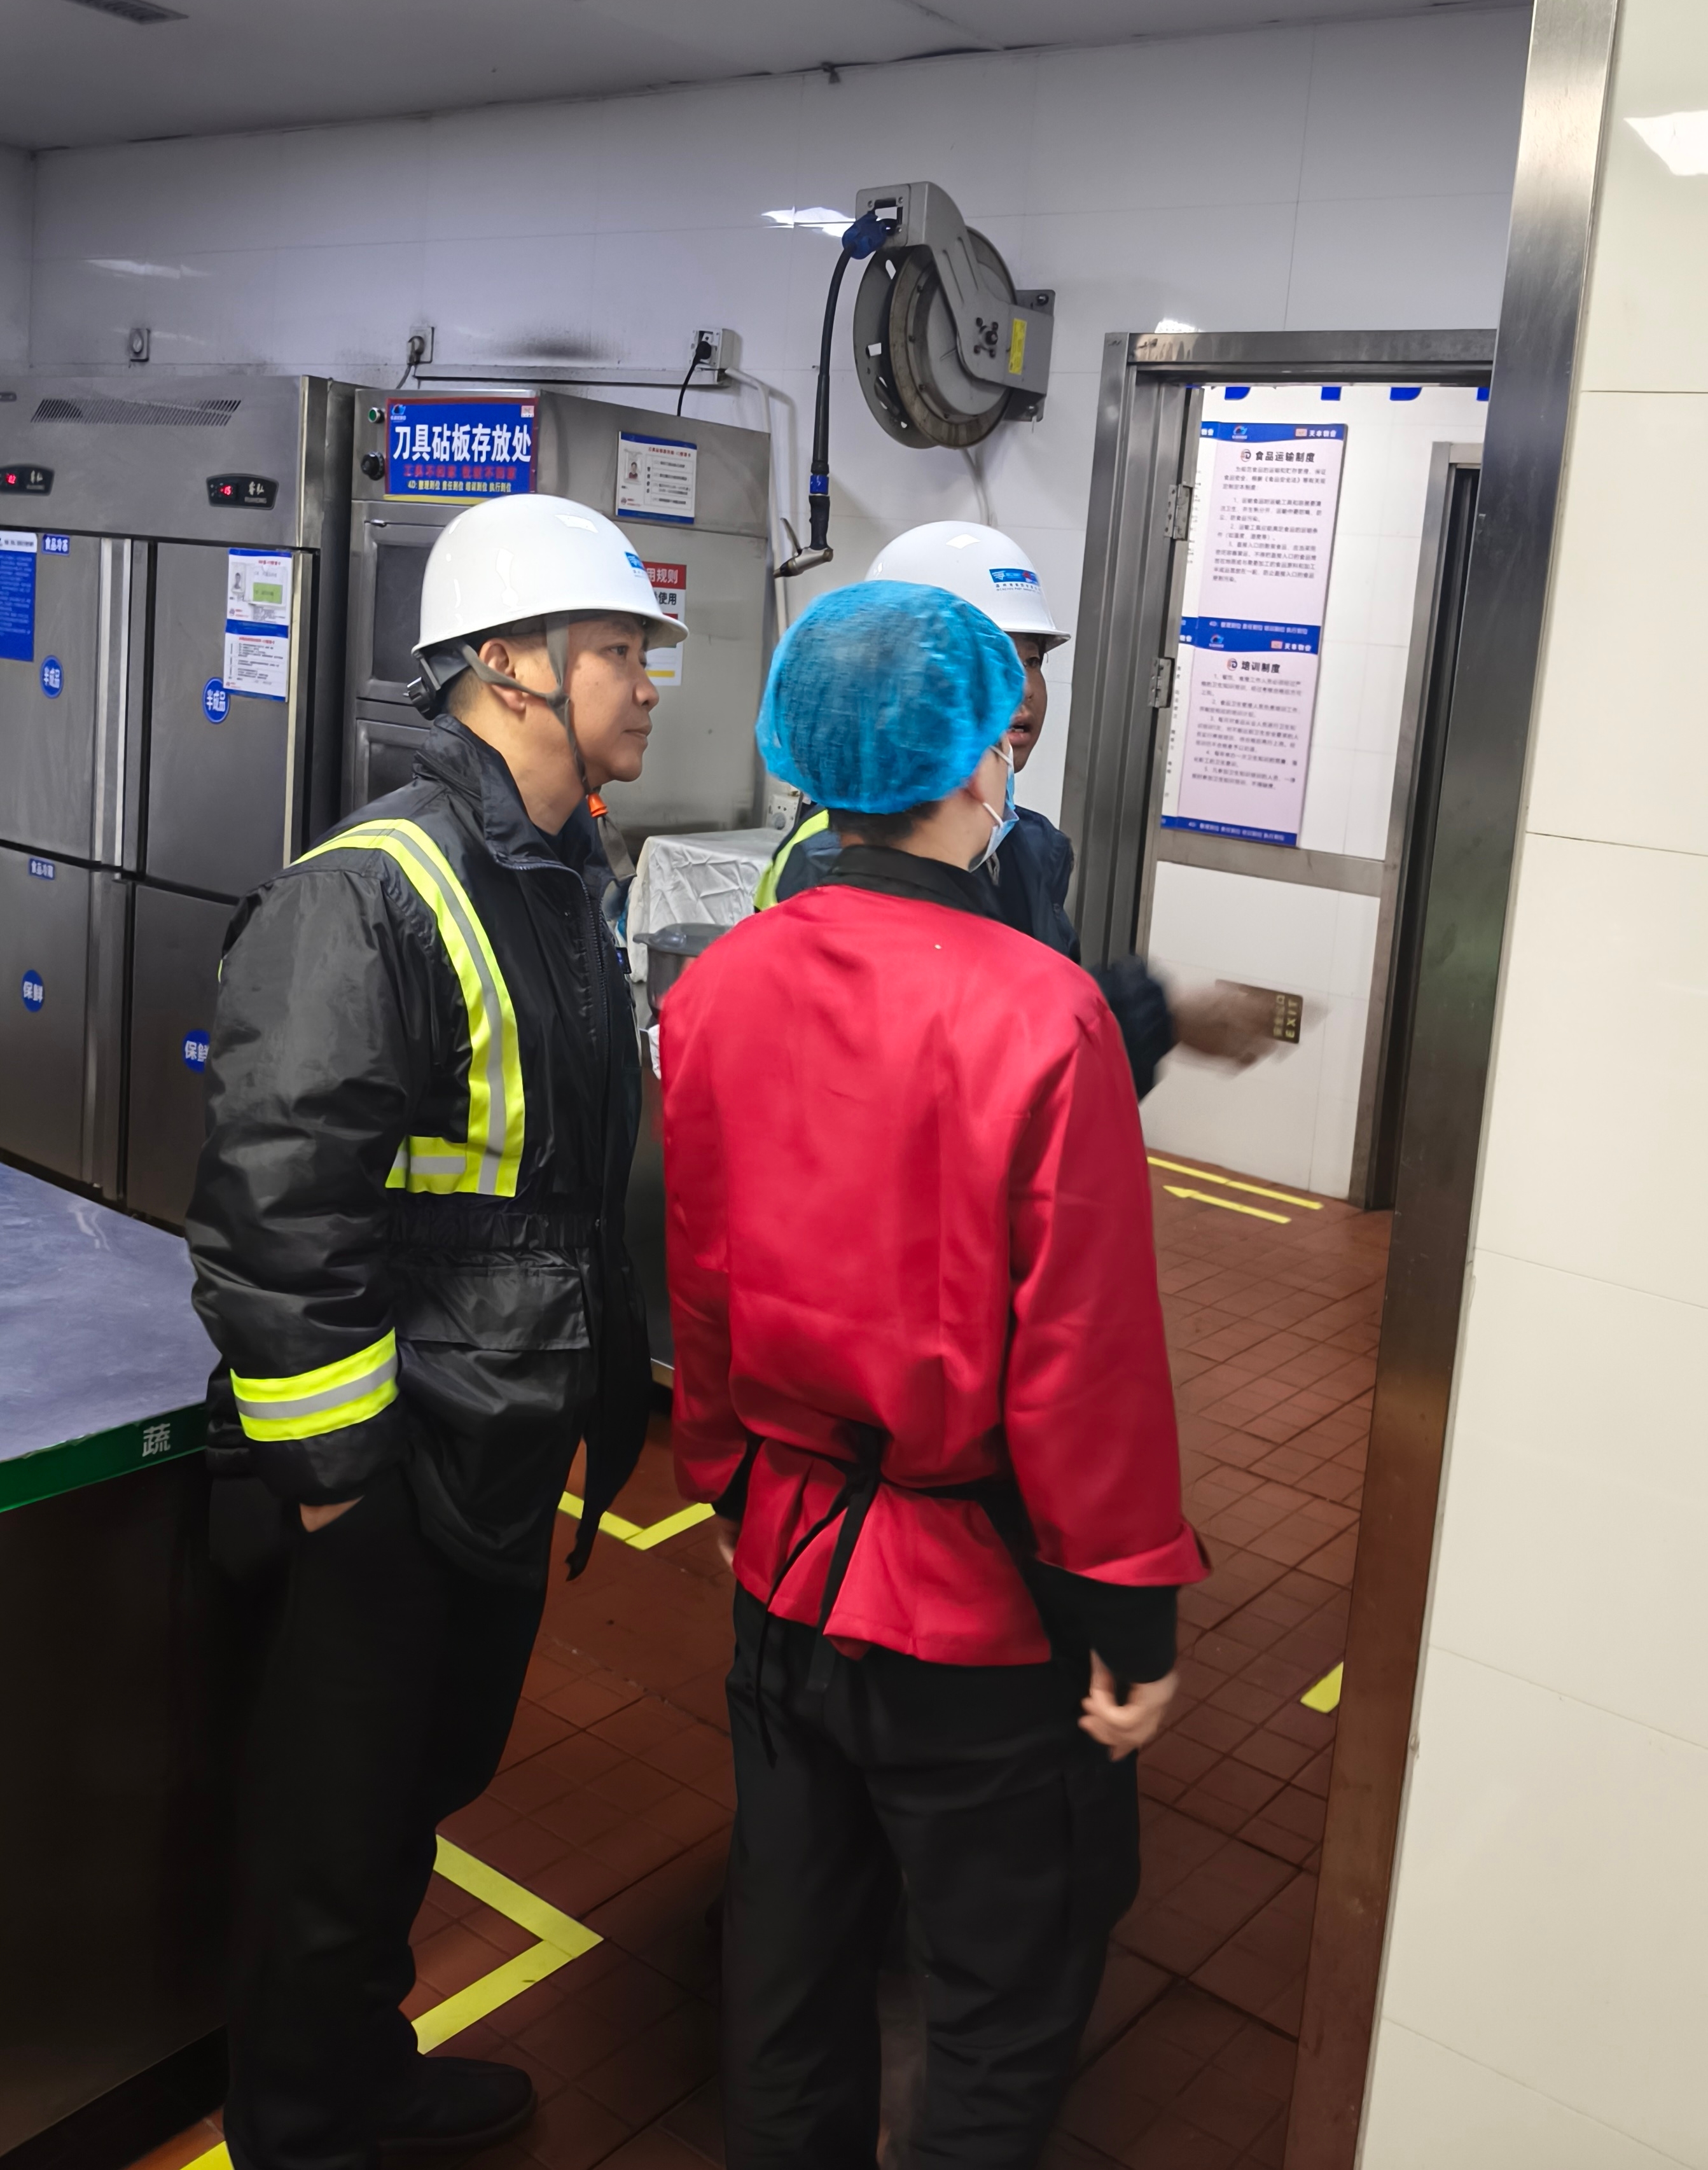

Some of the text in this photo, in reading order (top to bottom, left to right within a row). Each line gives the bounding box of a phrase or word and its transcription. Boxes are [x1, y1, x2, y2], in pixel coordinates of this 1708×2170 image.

[393, 423, 531, 463] 刀具砧板存放处
[1255, 450, 1316, 463] 食品运输制度
[1241, 660, 1281, 673] 培训制度
[1286, 999, 1298, 1038] EXIT
[142, 1422, 171, 1457] 蔬
